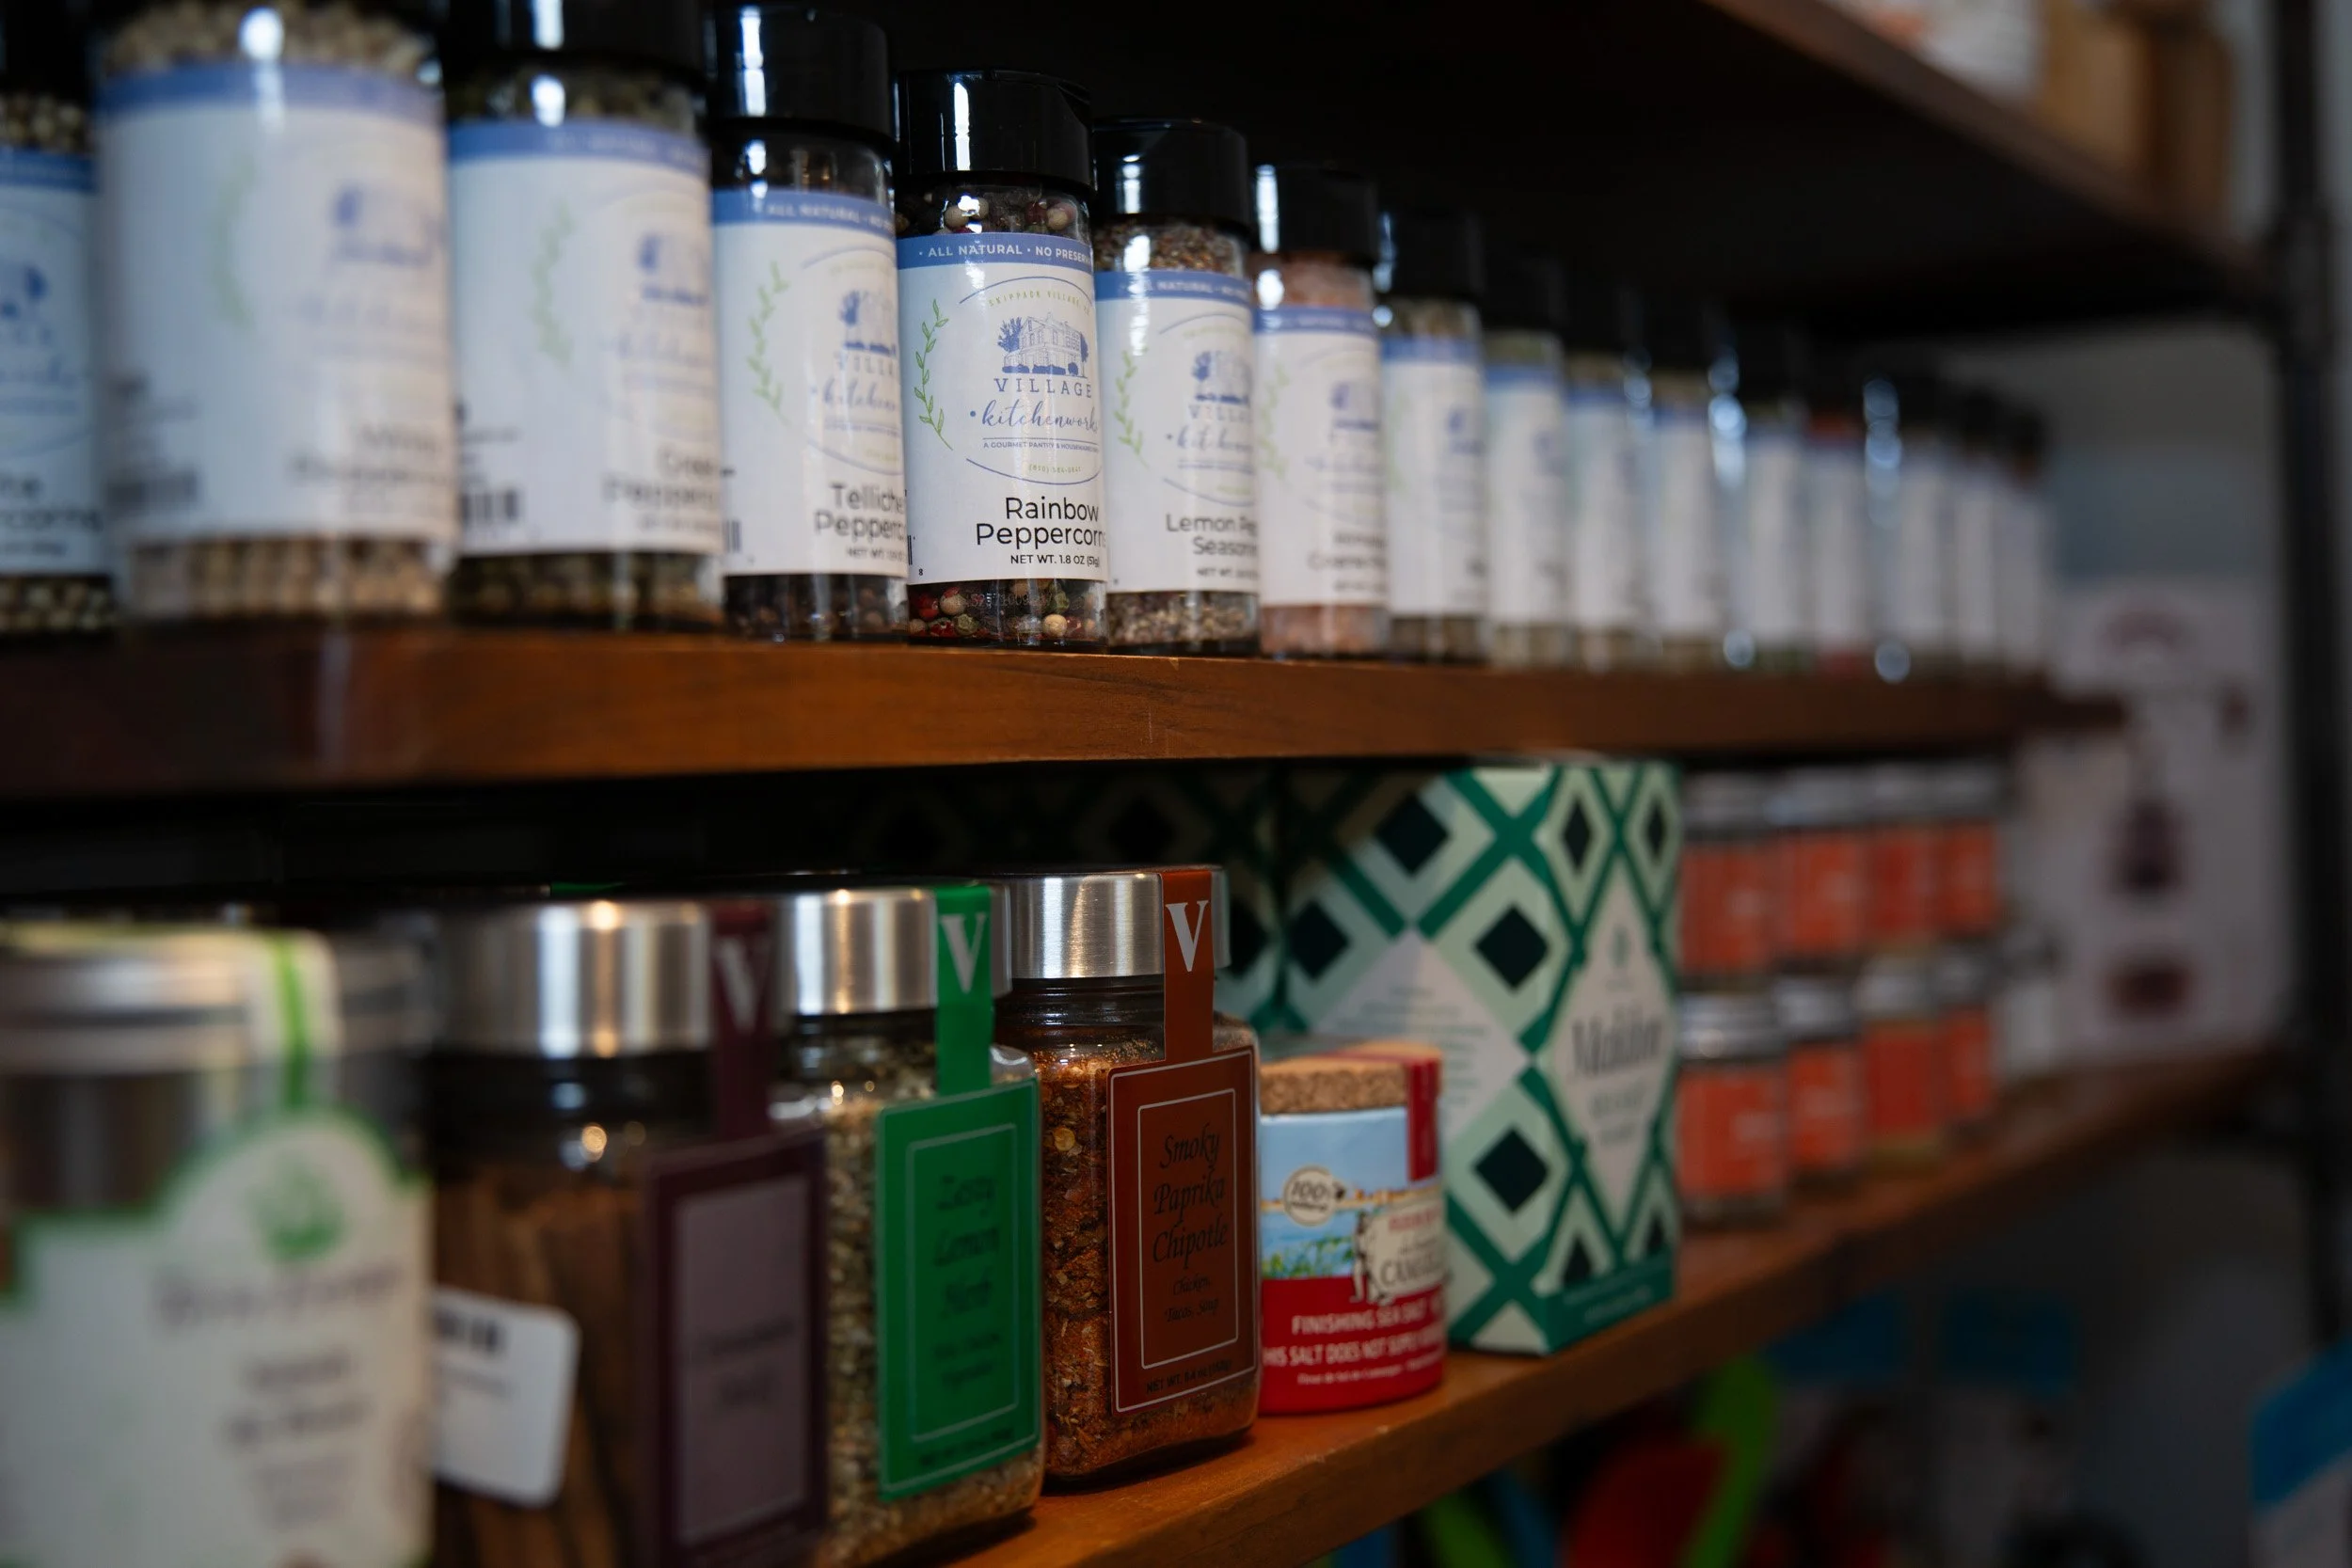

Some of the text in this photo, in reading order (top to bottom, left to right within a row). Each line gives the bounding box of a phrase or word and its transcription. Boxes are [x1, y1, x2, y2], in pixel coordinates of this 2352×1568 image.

[928, 245, 953, 258] ALL
[959, 245, 1024, 256] NATURAL
[1035, 246, 1053, 257] NO
[993, 378, 1092, 398] VILLAGE
[1006, 496, 1099, 522] Rainbow
[1166, 514, 1236, 533] Lemon
[1010, 554, 1034, 564] NET
[1036, 554, 1057, 564] WT.
[1059, 555, 1072, 564] 1.8
[1073, 555, 1086, 565] OZ
[1166, 900, 1209, 972] V
[940, 911, 986, 992] V
[716, 935, 772, 1027] V
[1159, 1122, 1220, 1168] Smoky
[1153, 1165, 1225, 1223] Paprika
[1152, 1212, 1228, 1270] Chipotle
[1292, 1308, 1375, 1336] FINISHING
[1289, 1343, 1324, 1366] SALT
[1146, 1378, 1163, 1394] NET
